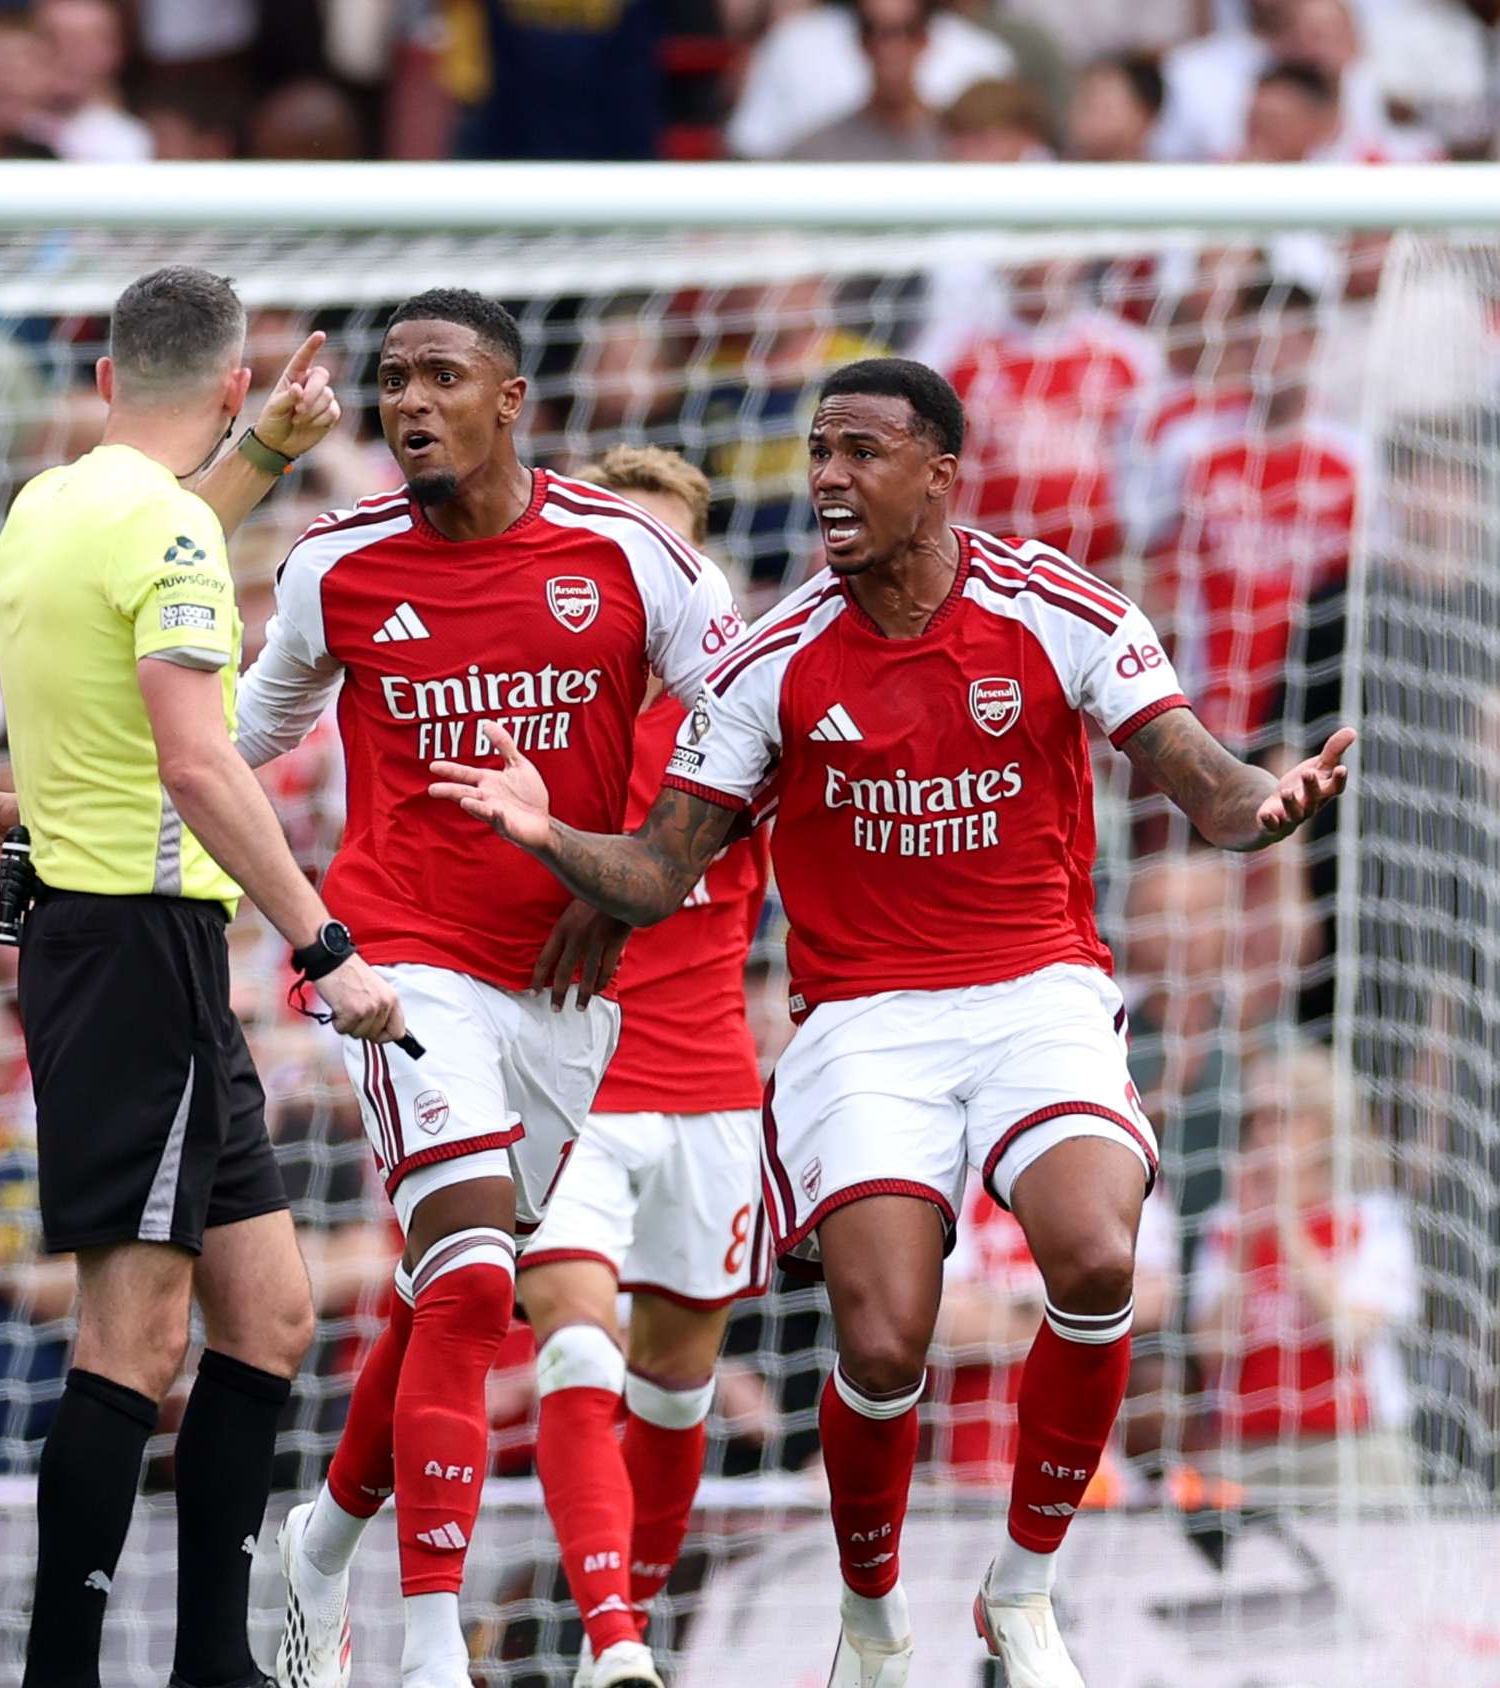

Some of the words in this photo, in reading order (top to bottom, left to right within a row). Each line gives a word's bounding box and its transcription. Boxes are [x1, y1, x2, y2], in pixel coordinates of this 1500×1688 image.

[554, 586, 592, 595] Arsenal
[1116, 643, 1164, 679] de
[380, 663, 601, 720] Emirates
[977, 687, 1013, 698] Arsenal
[419, 720, 464, 760] FLY
[824, 762, 1023, 816] Emirates
[854, 815, 894, 854] FLY
[899, 810, 999, 857] BETTER
[724, 1202, 752, 1275] 8
